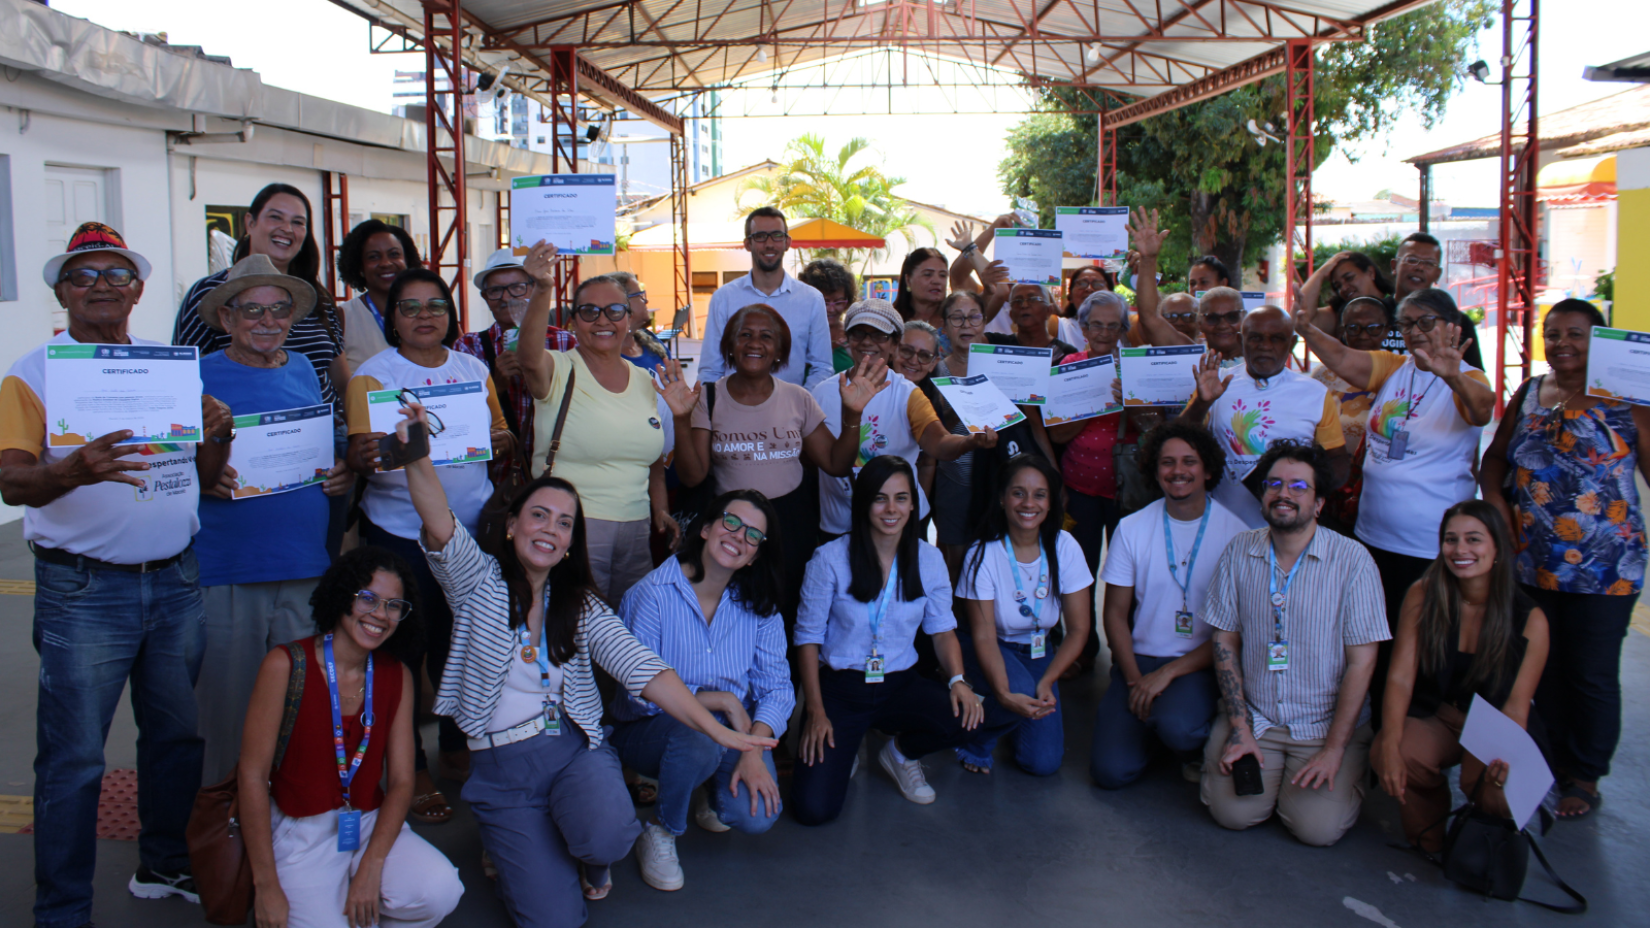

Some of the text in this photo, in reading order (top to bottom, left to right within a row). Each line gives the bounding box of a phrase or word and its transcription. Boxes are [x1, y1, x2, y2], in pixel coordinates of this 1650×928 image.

[1381, 339, 1406, 348] UGIR
[266, 428, 302, 437] CERTIFICADO
[723, 442, 755, 453] AMOR
[757, 441, 764, 451] E
[753, 452, 768, 461] NA
